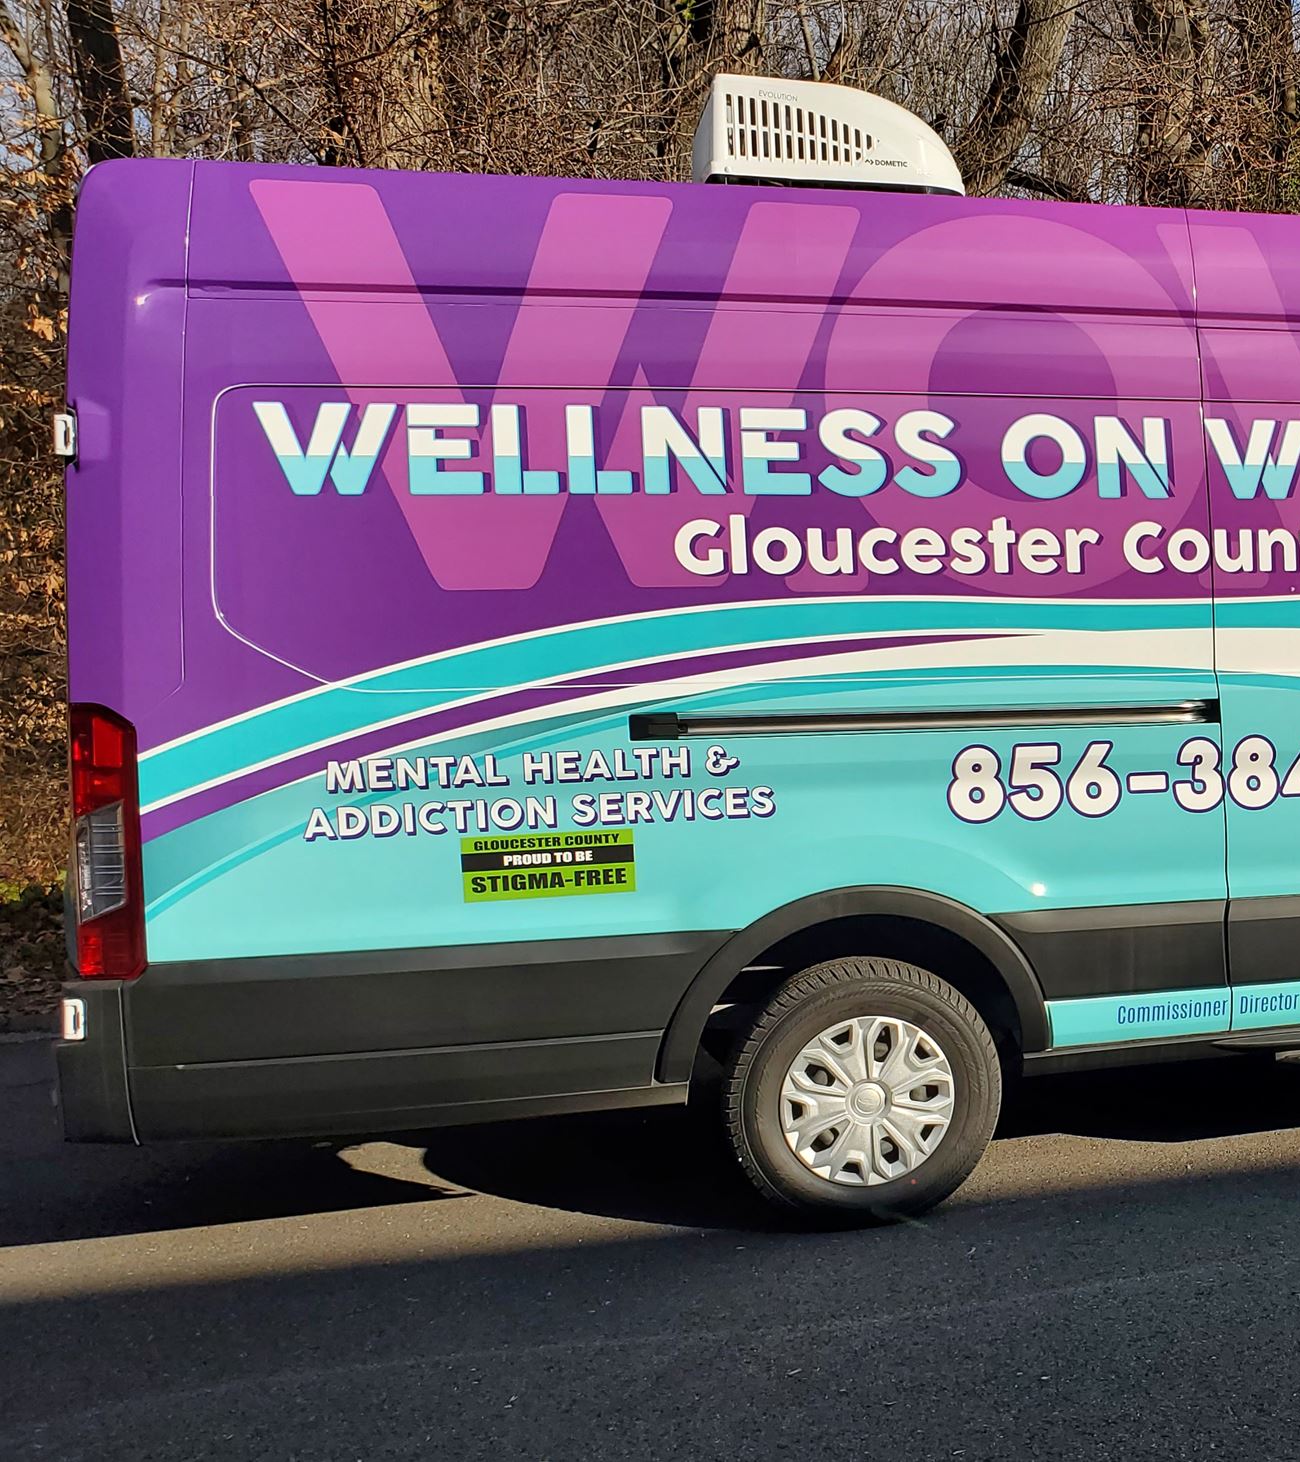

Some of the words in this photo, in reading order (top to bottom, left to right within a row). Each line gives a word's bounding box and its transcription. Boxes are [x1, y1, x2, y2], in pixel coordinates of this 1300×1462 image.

[758, 89, 798, 102] EVOLUTION
[874, 159, 908, 168] DOMETIC
[253, 401, 963, 497] WELLNESS
[1001, 413, 1179, 502] ON
[674, 513, 1101, 576] Gloucester
[325, 755, 509, 795] MENTAL
[522, 745, 691, 784] HEALTH
[704, 744, 741, 776] &
[303, 795, 558, 842] ADDICTION
[570, 785, 777, 826] SERVICES
[474, 837, 561, 851] GLOUCESTER
[564, 833, 620, 846] COUNTY
[503, 852, 551, 866] PROUD
[553, 851, 573, 863] TO
[574, 850, 594, 862] BE
[471, 867, 628, 894] STIGMA-FREE
[1117, 999, 1228, 1025] Commissioner
[1239, 992, 1300, 1015] Director
